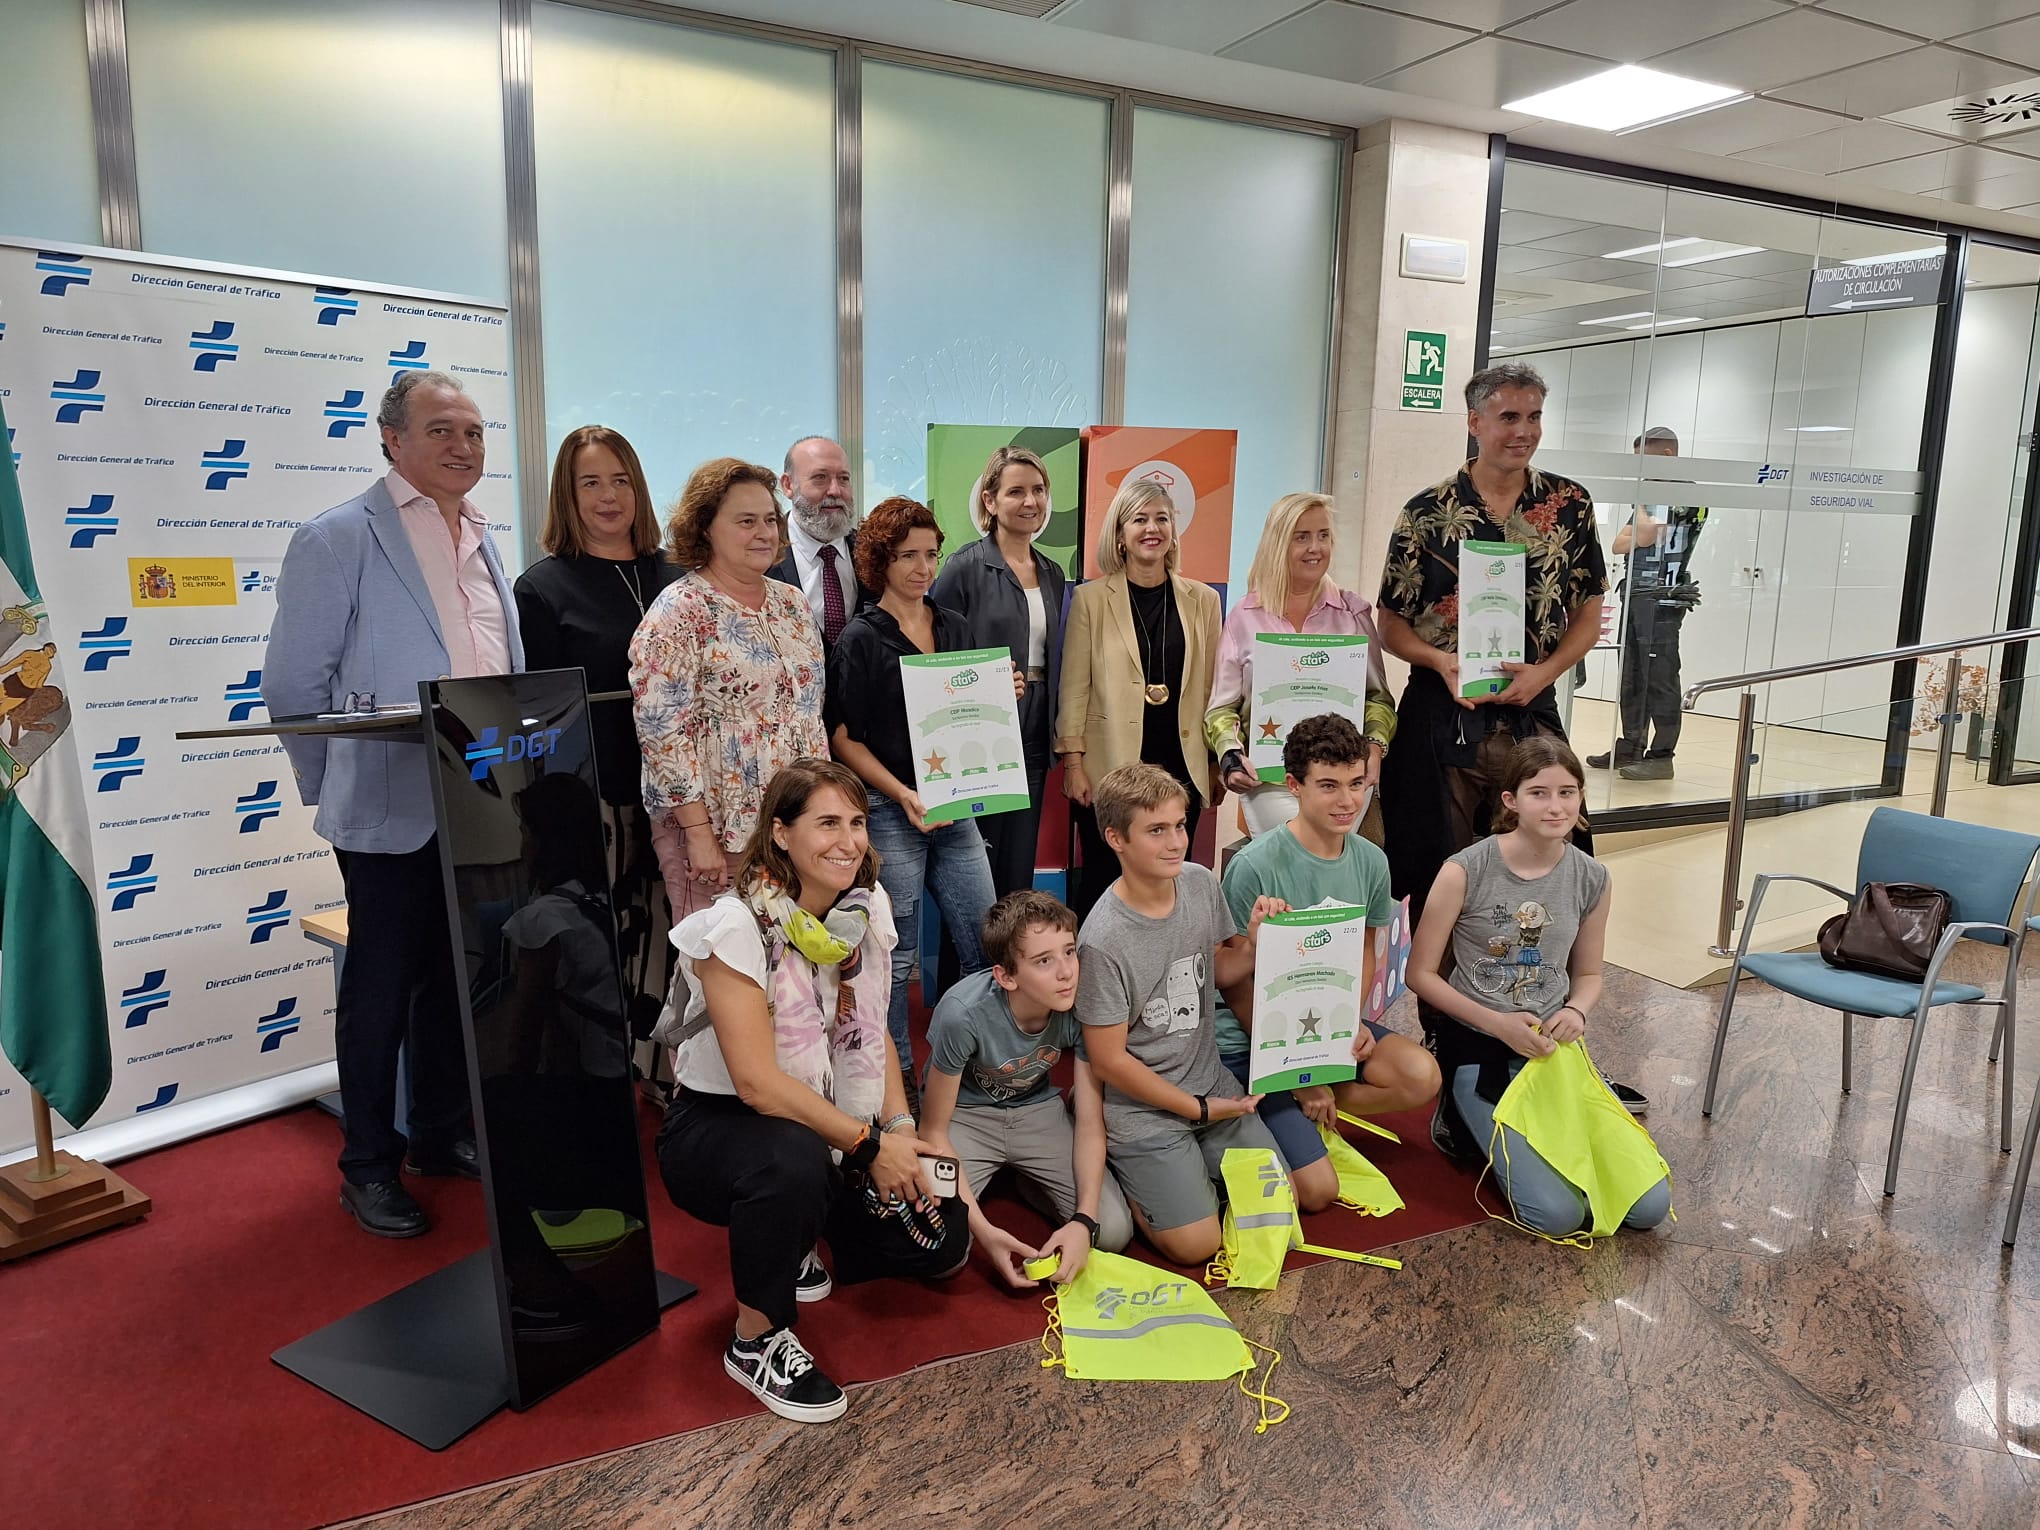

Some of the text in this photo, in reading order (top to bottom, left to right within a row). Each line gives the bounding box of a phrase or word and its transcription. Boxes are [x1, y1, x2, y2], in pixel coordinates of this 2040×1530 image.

[1814, 258, 1941, 283] AUTORIZACIONES COMPLEMENTARIAS
[131, 272, 280, 299] Dirección General de Tráfico
[1843, 276, 1903, 296] DE CIRCULACIÓN
[383, 303, 502, 326] Dirección General de Tráfico
[42, 326, 162, 344] Dirección General de Tráfico
[264, 348, 364, 363] Dirección General de Tráfico
[450, 364, 480, 374] Dirección
[480, 367, 502, 376] General
[1404, 388, 1440, 400] ESCALERA
[144, 397, 291, 415] Dirección General de Tráfico
[57, 454, 174, 466] Dirección General de Tráfico
[274, 462, 308, 470] Dirección
[310, 464, 337, 472] General
[347, 465, 372, 473] Tráfico
[1770, 469, 1789, 480] DGT
[1810, 471, 1884, 484] INVESTIGACIÓN DE
[1810, 496, 1874, 508] SEGURIDAD VIAL
[156, 518, 302, 529] Dirección General de Tráfico
[486, 524, 512, 532] Tráfico
[262, 584, 272, 592] de
[169, 634, 271, 646] Dirección General d
[1300, 652, 1329, 666] stars
[951, 672, 979, 688] stars
[85, 694, 198, 710] Dirección General de Tráfico
[507, 728, 562, 762] DGT
[181, 750, 230, 762] Dirección
[232, 747, 270, 758] General
[99, 818, 138, 830] Dirección
[140, 814, 170, 824] General
[182, 810, 210, 818] Tráfico
[193, 849, 330, 878] Dirección General de Tráfico
[314, 900, 346, 910] Dirección
[113, 922, 222, 948] Dirección General de Tráfico
[1304, 933, 1332, 948] stars
[205, 956, 334, 990] Dirección General de Tráfic
[127, 1033, 234, 1065] Dirección General de Tráfico
[1130, 1283, 1188, 1305] DGT
